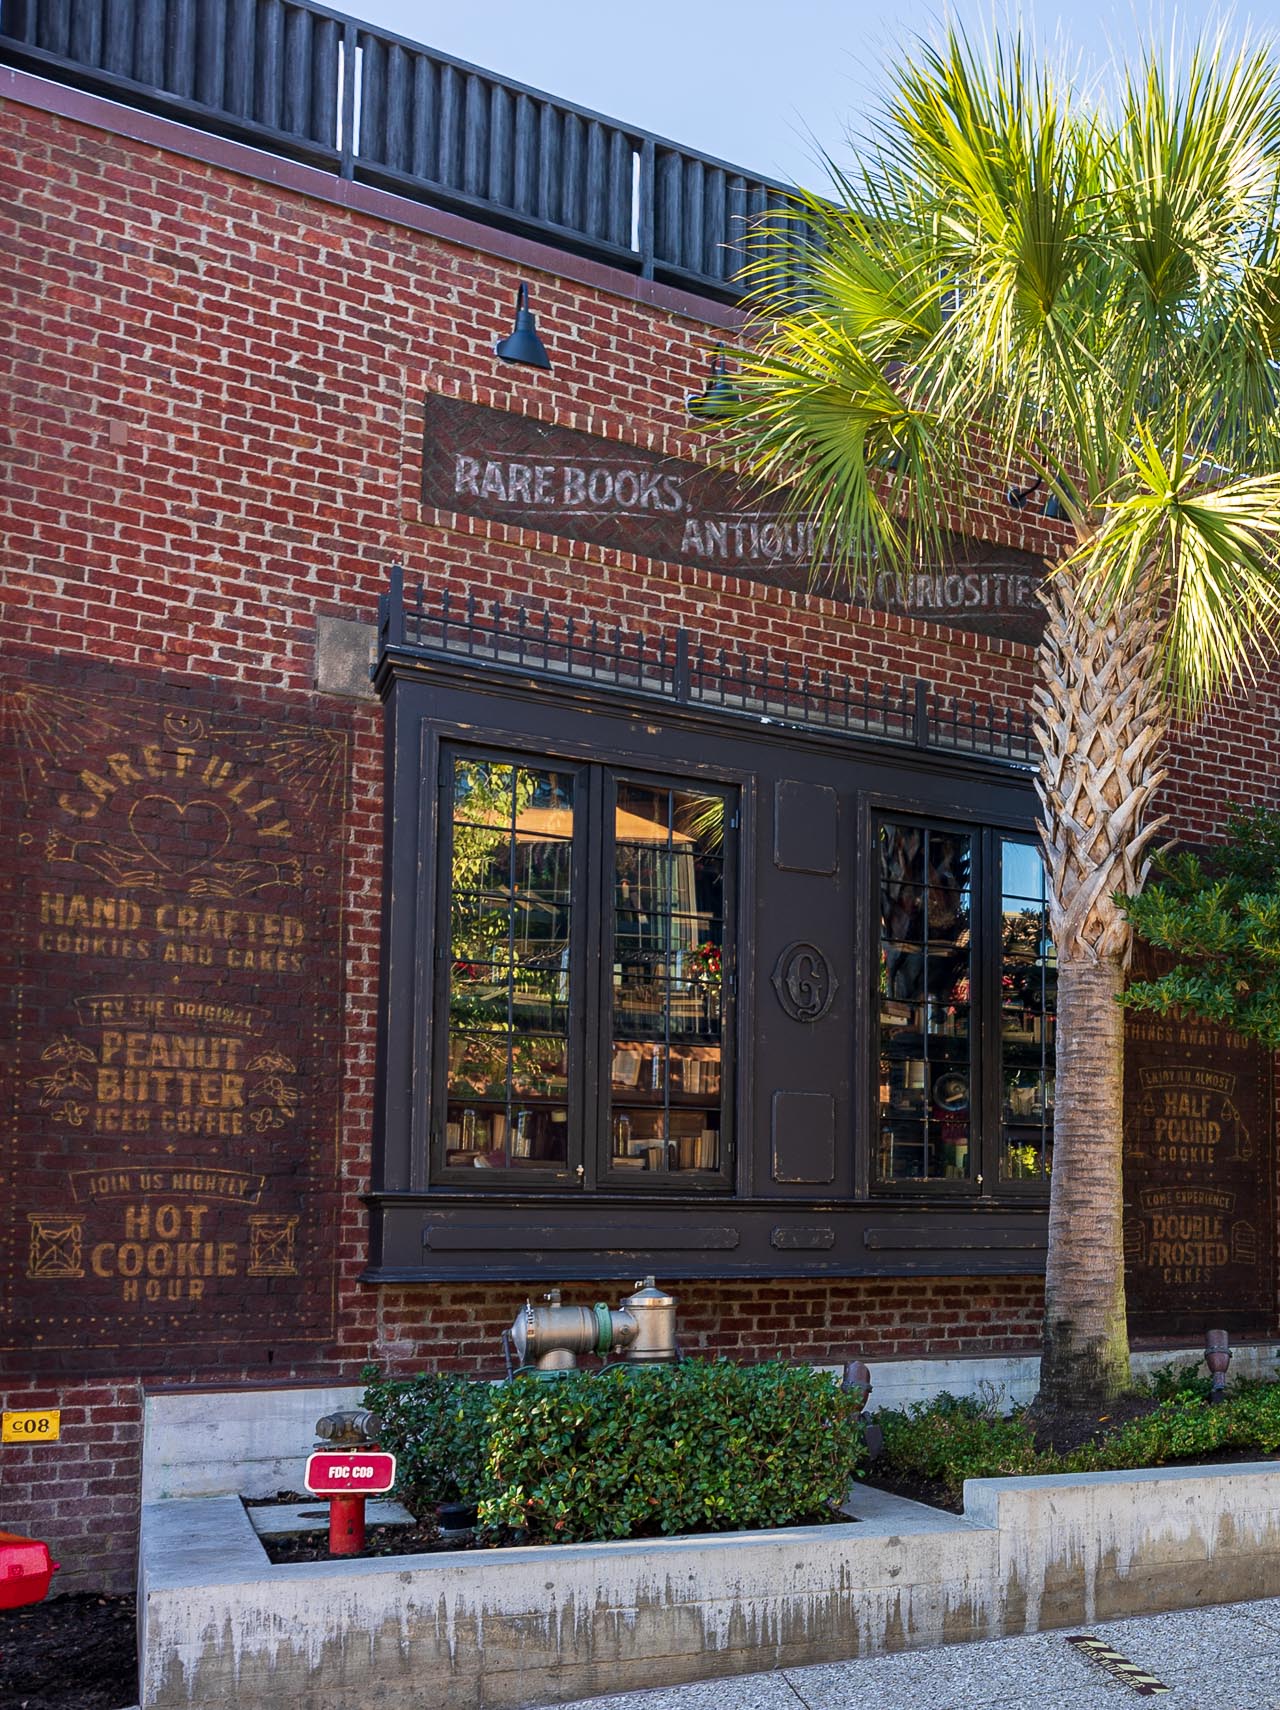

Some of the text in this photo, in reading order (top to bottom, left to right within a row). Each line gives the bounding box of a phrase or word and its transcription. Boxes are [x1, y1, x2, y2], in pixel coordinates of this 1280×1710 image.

[455, 453, 555, 504] RARE
[59, 744, 293, 838] CAREFULLY
[40, 891, 304, 947] HAND CRAFTED
[39, 932, 302, 972] COOKIES AND CAKES
[90, 1000, 252, 1027] TRY THE ORIGINAL
[102, 1031, 244, 1070] PEANUT
[97, 1067, 245, 1107] BUTTER
[1164, 1091, 1211, 1118] HALF
[95, 1107, 243, 1135] ICED COFFEE
[1155, 1117, 1221, 1144] POUND
[1158, 1146, 1215, 1164] COOKIE
[89, 1174, 249, 1196] JOIN US NIGHTLY
[125, 1204, 208, 1239] HOT
[1152, 1214, 1224, 1240] DOUBLE
[91, 1242, 239, 1277] COOKIE
[1148, 1241, 1228, 1266] FROSTED
[123, 1279, 206, 1301] HOUR
[328, 1466, 374, 1479] FDC C08
